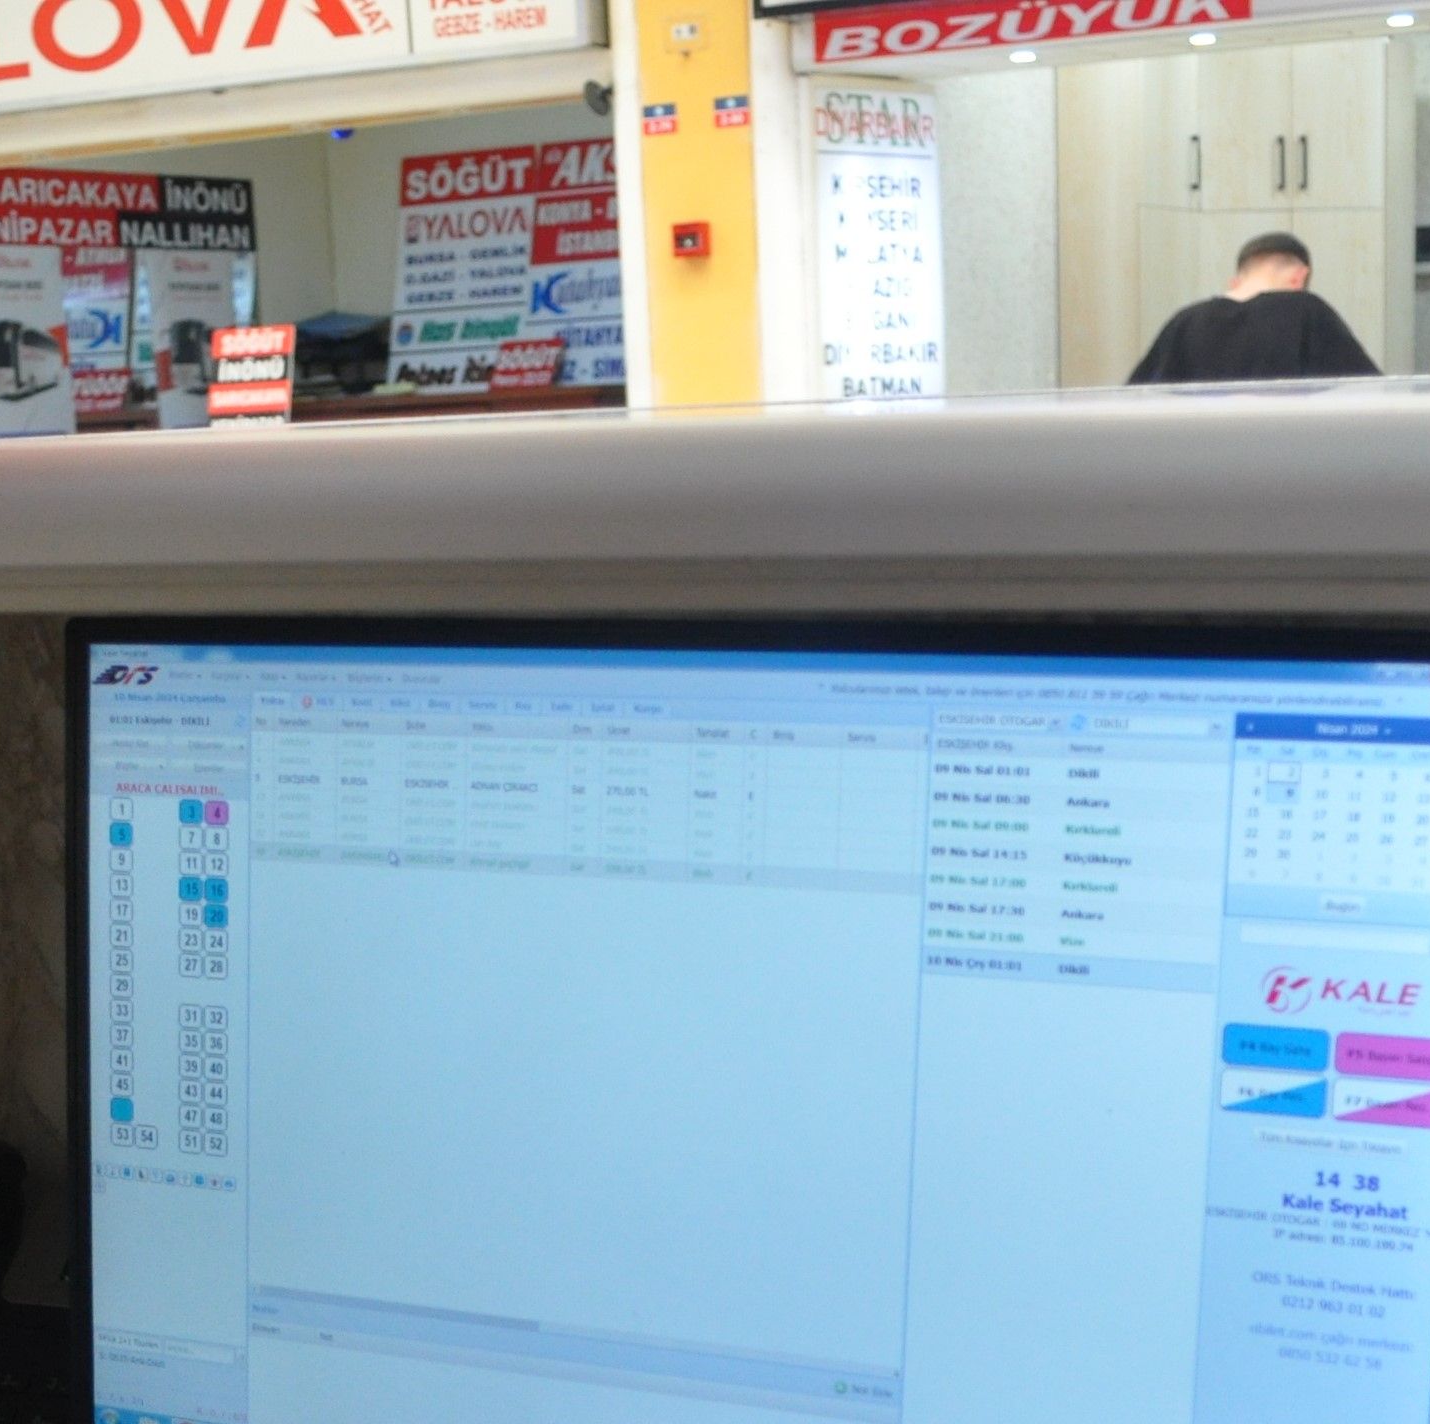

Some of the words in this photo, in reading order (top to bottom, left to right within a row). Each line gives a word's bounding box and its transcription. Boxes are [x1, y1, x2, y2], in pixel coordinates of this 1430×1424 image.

[405, 155, 532, 201] SÖĞÜT
[165, 179, 249, 213] İNÖNÜ
[120, 221, 251, 249] NALLIHAN
[423, 207, 528, 243] YALOVA
[218, 358, 286, 382] İNÖNÜ
[188, 831, 196, 844] 7
[185, 857, 198, 870] 11
[210, 858, 223, 871] 12
[115, 878, 128, 891] 13
[185, 883, 198, 896] 15
[210, 884, 223, 897] 16
[115, 903, 128, 916] 17
[185, 908, 198, 921] 19
[210, 909, 223, 922] 20
[115, 929, 128, 942] 21
[185, 933, 198, 946] 23
[210, 935, 223, 948] 24
[115, 954, 128, 967] 25
[185, 959, 198, 972] 27
[210, 960, 223, 973] 28
[115, 979, 128, 992] 29
[1320, 977, 1423, 1007] KALE
[115, 1004, 128, 1017] 33
[185, 1011, 198, 1024] 31
[210, 1011, 223, 1024] 32
[115, 1029, 128, 1042] 37
[185, 1035, 198, 1048] 35
[210, 1037, 223, 1050] 36
[115, 1054, 128, 1067] 41
[185, 1060, 198, 1073] 39
[210, 1062, 223, 1075] 40
[115, 1078, 128, 1091] 45
[185, 1085, 198, 1098] 43
[210, 1087, 223, 1100] 44
[185, 1110, 198, 1123] 47
[210, 1112, 223, 1125] 48
[115, 1128, 128, 1141] 53
[141, 1129, 153, 1142] 54
[185, 1135, 198, 1148] 51
[210, 1137, 223, 1150] 52
[1352, 1174, 1381, 1192] 38
[1282, 1193, 1324, 1212] Kale
[1329, 1197, 1409, 1221] Seyahat
